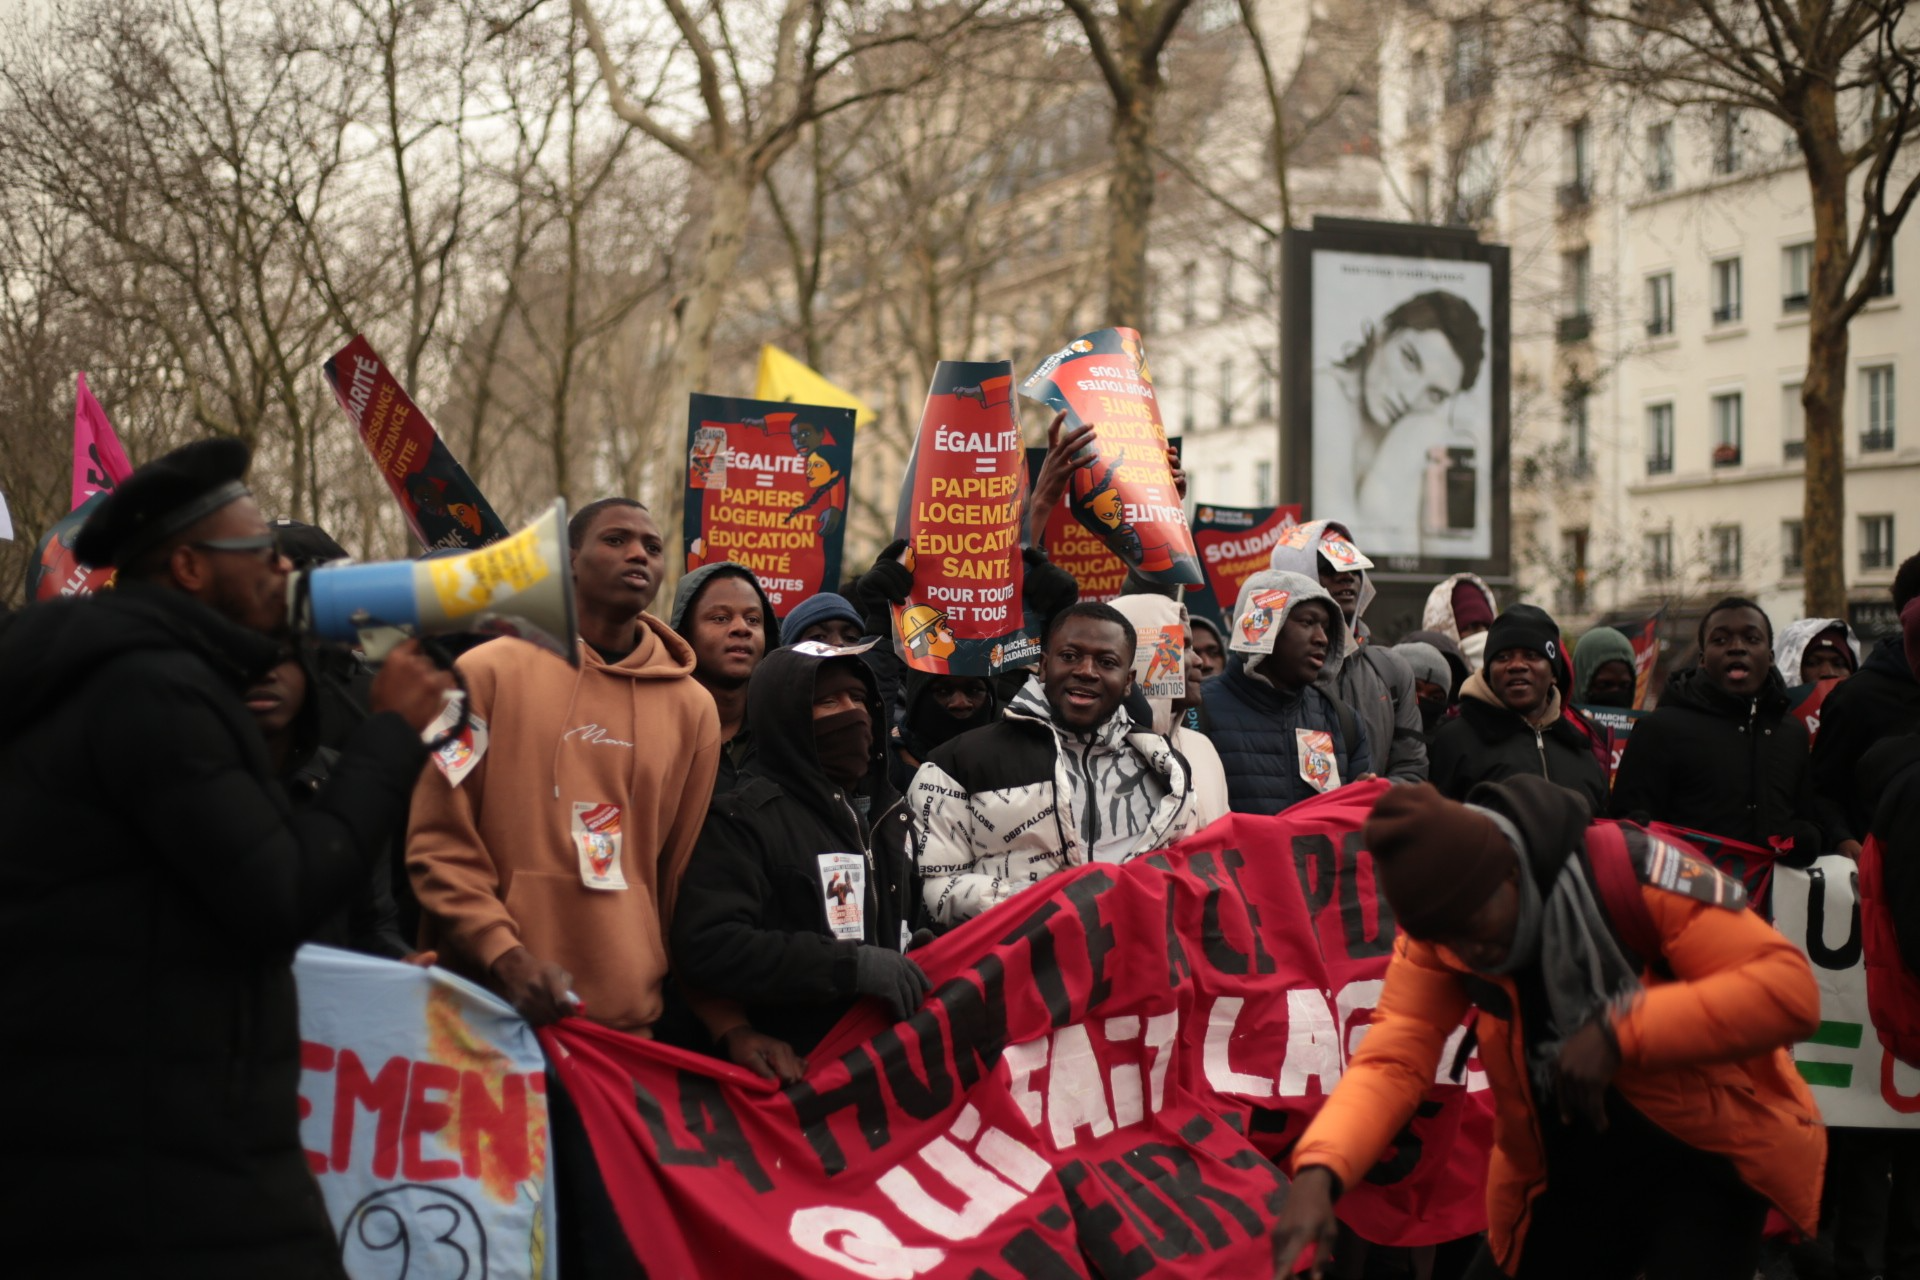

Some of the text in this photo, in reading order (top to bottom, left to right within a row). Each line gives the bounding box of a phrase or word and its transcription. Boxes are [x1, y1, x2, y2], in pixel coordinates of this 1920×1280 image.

[1089, 366, 1120, 379] TOUS
[1076, 379, 1126, 394] TOUTES
[1100, 396, 1153, 419] SANTÉ
[934, 425, 1017, 452] ÉGALITÉ
[391, 438, 419, 479] LUTTE
[724, 446, 805, 474] ÉGALITÉ
[720, 488, 805, 507] PAPIERS
[931, 473, 1017, 498] PAPIERS
[710, 505, 816, 531] LOGEMENT
[919, 500, 1021, 525] LOGEMENT
[708, 526, 815, 549] ÉDUCATION
[727, 548, 791, 574] SANTÉ
[942, 552, 1011, 580] SANTÉ
[927, 583, 1014, 603] POUR TOUTES
[945, 603, 1008, 622] ET TOUS
[1003, 638, 1028, 653] MARCHE
[1003, 644, 1042, 664] SOLIDARITÉS
[1594, 712, 1628, 722] MARCHE
[632, 1069, 775, 1194] LA
[358, 1203, 470, 1280] 93
